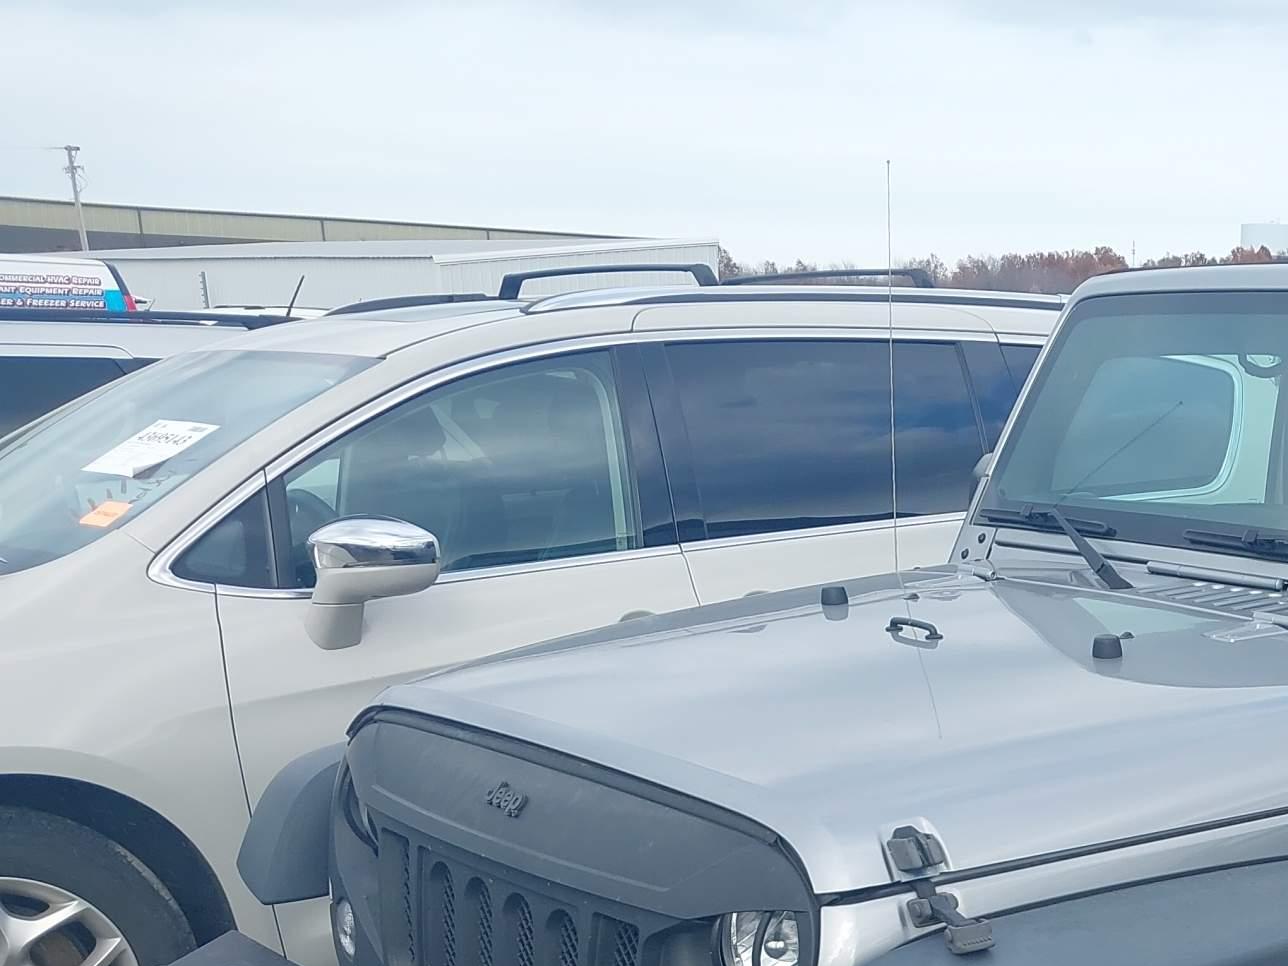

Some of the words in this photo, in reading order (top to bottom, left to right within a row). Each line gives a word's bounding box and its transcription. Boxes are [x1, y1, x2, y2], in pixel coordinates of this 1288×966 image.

[0, 274, 46, 284] OMMERCIAL
[47, 275, 71, 284] HVAC
[71, 276, 101, 286] REPAIR
[0, 285, 17, 295] ANT
[20, 286, 70, 296] EQUIPMENT
[72, 288, 104, 297] REPAIR
[16, 299, 24, 307] &
[26, 298, 67, 308] FREEZER
[69, 300, 105, 309] SERVICE
